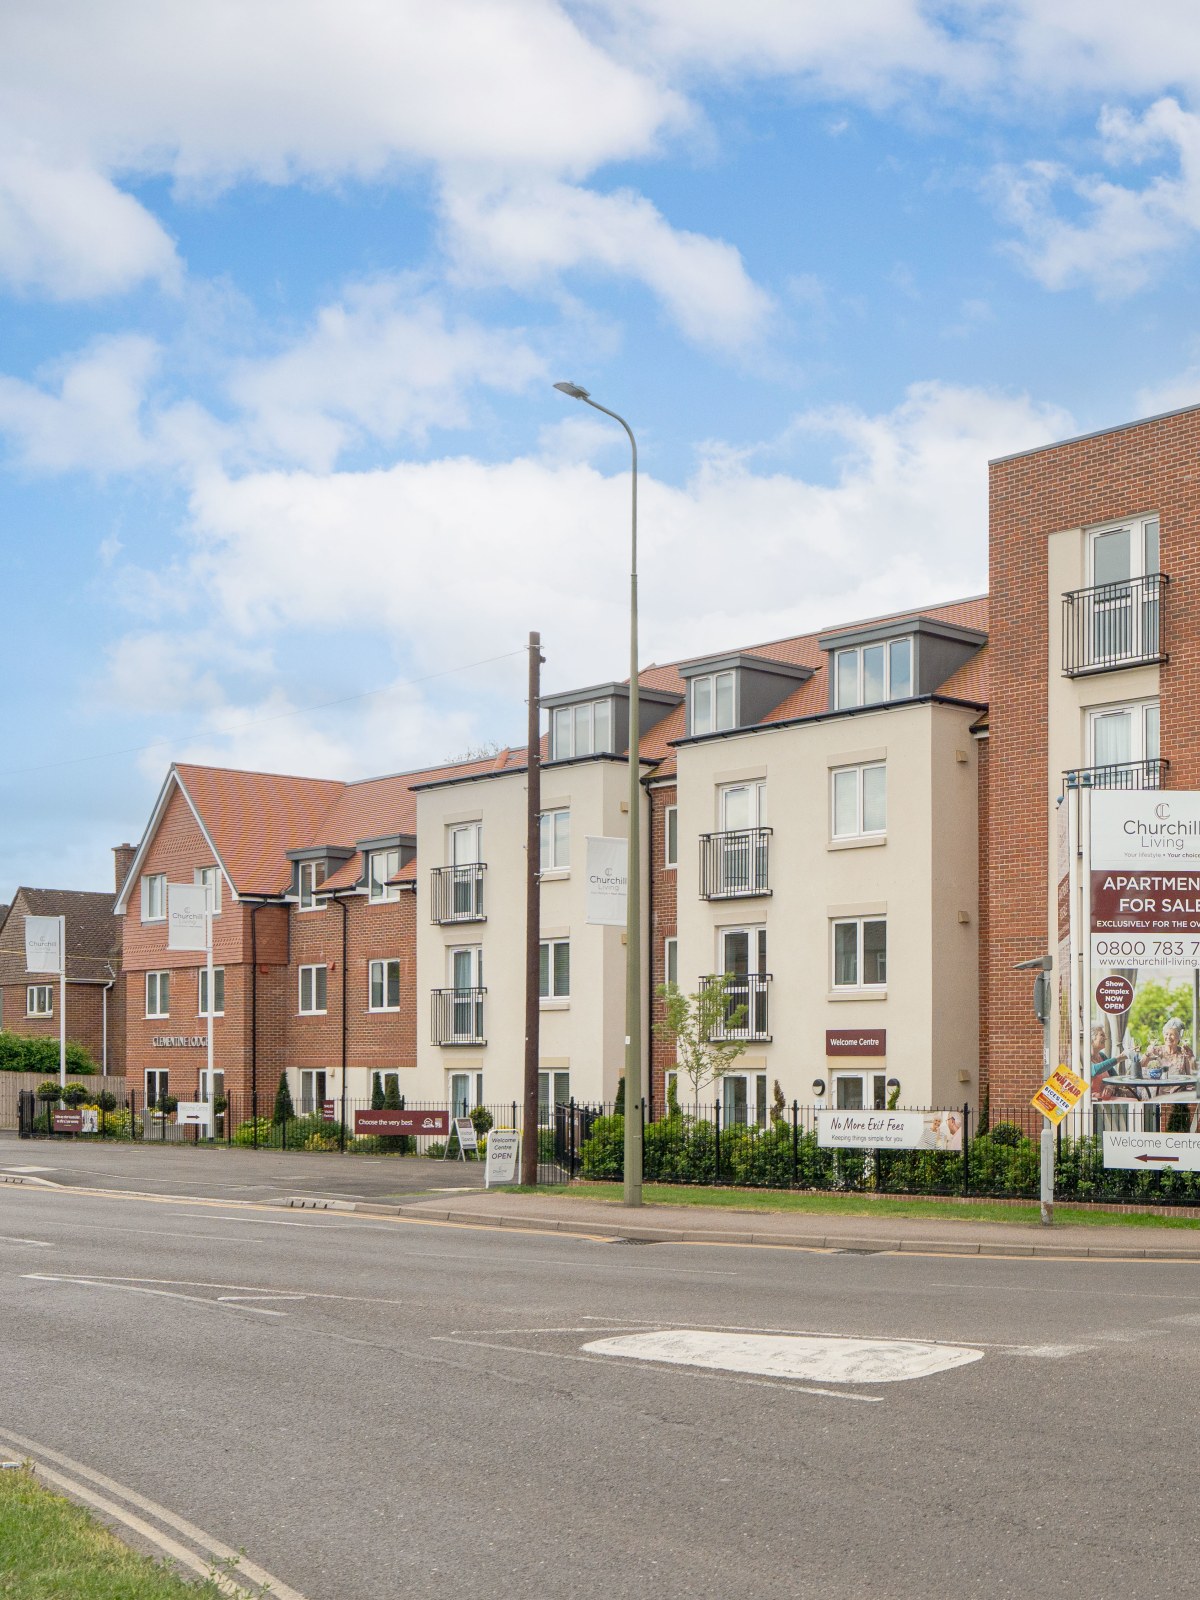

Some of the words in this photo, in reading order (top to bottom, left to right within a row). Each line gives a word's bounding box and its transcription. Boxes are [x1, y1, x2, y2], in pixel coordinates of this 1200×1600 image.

[1141, 836, 1184, 850] Living
[1119, 899, 1155, 912] FOR
[1096, 941, 1146, 955] 0800
[1152, 941, 1184, 956] 783
[830, 1038, 858, 1046] Welcome
[859, 1038, 880, 1046] Centre
[1053, 1072, 1067, 1087] FUN
[1065, 1082, 1081, 1098] FAIR
[1045, 1086, 1070, 1109] BICESTER
[831, 1117, 842, 1130] No
[843, 1117, 865, 1130] More
[868, 1117, 884, 1131] Exit
[887, 1118, 905, 1131] Fees
[832, 1134, 851, 1142] Keeping
[1110, 1136, 1161, 1148] Welcome
